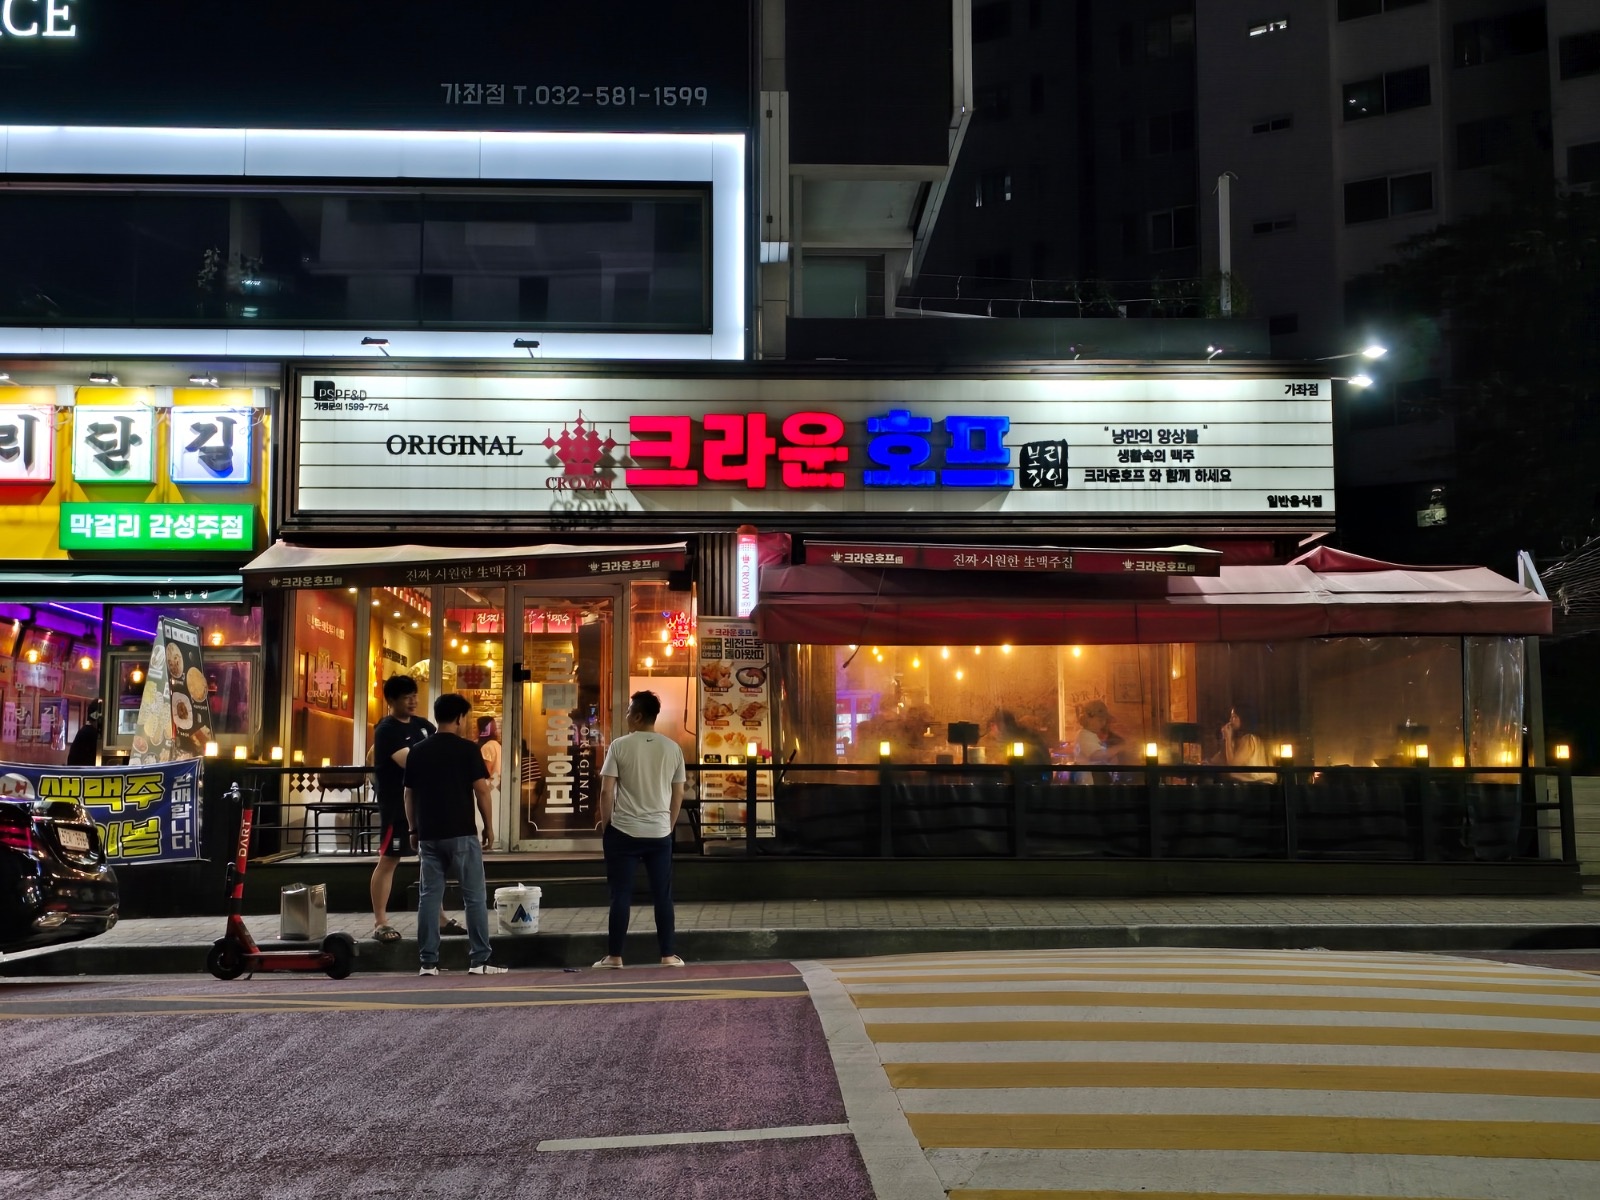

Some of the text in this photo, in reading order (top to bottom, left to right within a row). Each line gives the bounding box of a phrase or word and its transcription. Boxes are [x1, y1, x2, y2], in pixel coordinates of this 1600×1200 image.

[441, 83, 505, 105] 가좌점
[1284, 383, 1319, 397] 가좌점
[345, 403, 389, 411] 1599-7754
[386, 434, 523, 456] ORIGINAL
[1027, 445, 1063, 467] 보리
[1170, 448, 1195, 463] 맥주
[1026, 467, 1064, 488] 장인
[1084, 468, 1232, 482] 크라운호프 와 함께 하세요
[545, 476, 612, 490] CROWN
[1266, 495, 1323, 508] 일반음식점
[70, 513, 244, 539] 막걸리 감성주점
[601, 559, 652, 572] 크라운호프
[843, 553, 895, 565] 크라운호프
[953, 553, 1073, 569] 진짜 시원한 生맥주집
[1135, 560, 1187, 573] 크라운호프
[406, 569, 431, 581] 진짜
[434, 566, 474, 581] 시원한
[281, 575, 334, 588] 크라운호프
[741, 565, 750, 600] CROWN
[715, 628, 752, 637] 크라운호프
[724, 637, 765, 649] 레전드로
[579, 724, 590, 813] ORIGINAL
[170, 773, 193, 851] 판매합니다
[238, 819, 251, 857] DART
